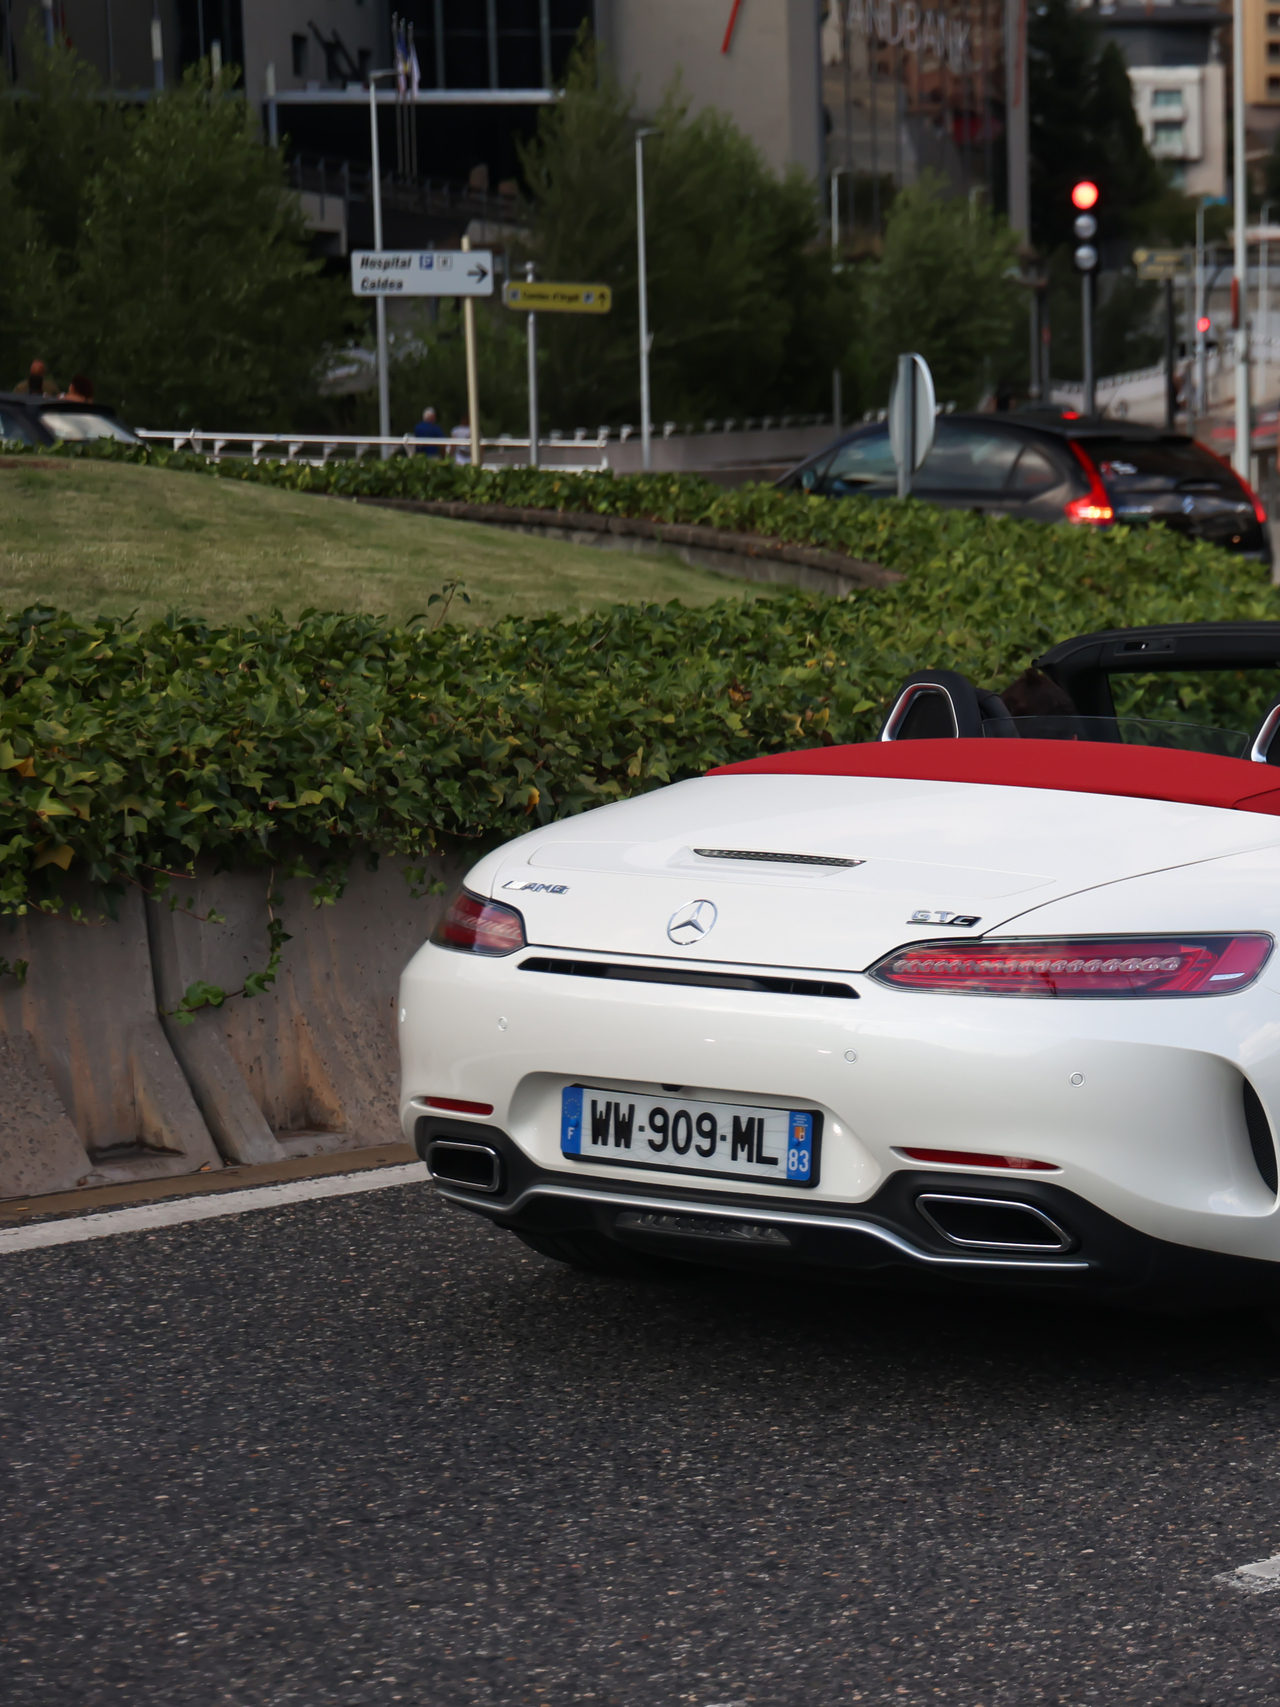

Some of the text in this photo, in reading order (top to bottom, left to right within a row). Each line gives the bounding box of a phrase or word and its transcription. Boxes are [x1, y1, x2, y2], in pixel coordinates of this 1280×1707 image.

[360, 254, 412, 272] Hospital
[566, 1126, 576, 1140] F
[788, 1148, 809, 1172] 83
